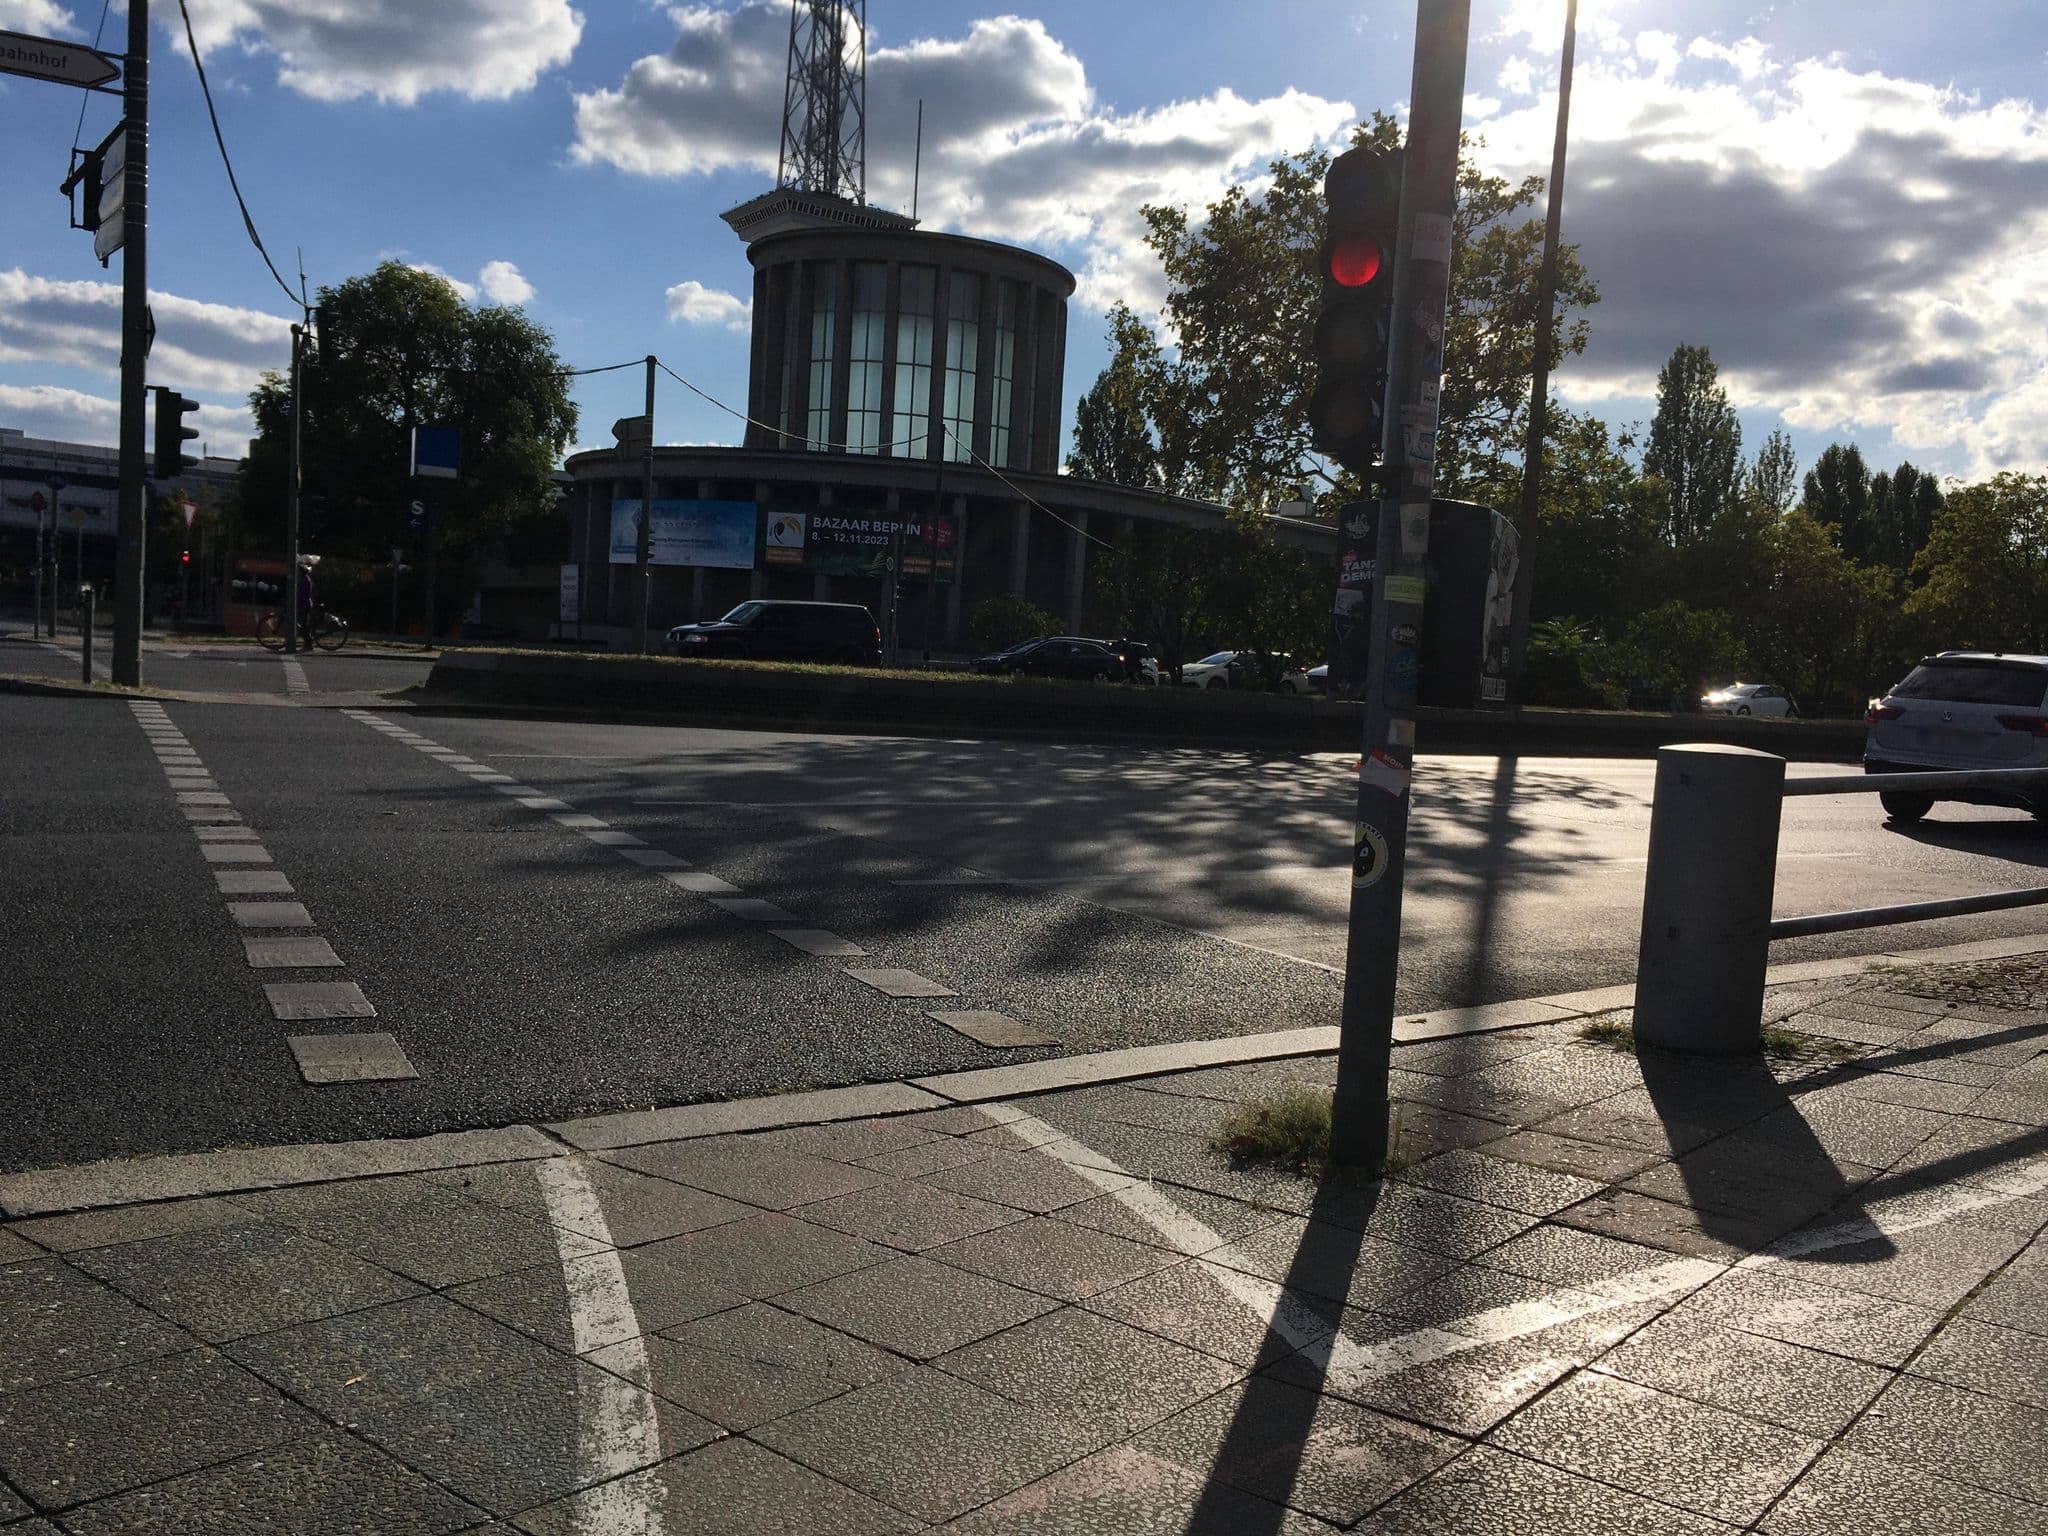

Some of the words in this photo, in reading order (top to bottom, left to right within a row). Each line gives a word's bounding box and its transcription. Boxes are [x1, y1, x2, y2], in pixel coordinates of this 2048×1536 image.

[411, 500, 424, 515] S
[812, 516, 869, 531] BAZAAR
[811, 531, 821, 541] 8.
[833, 532, 889, 545] 12.11.2023
